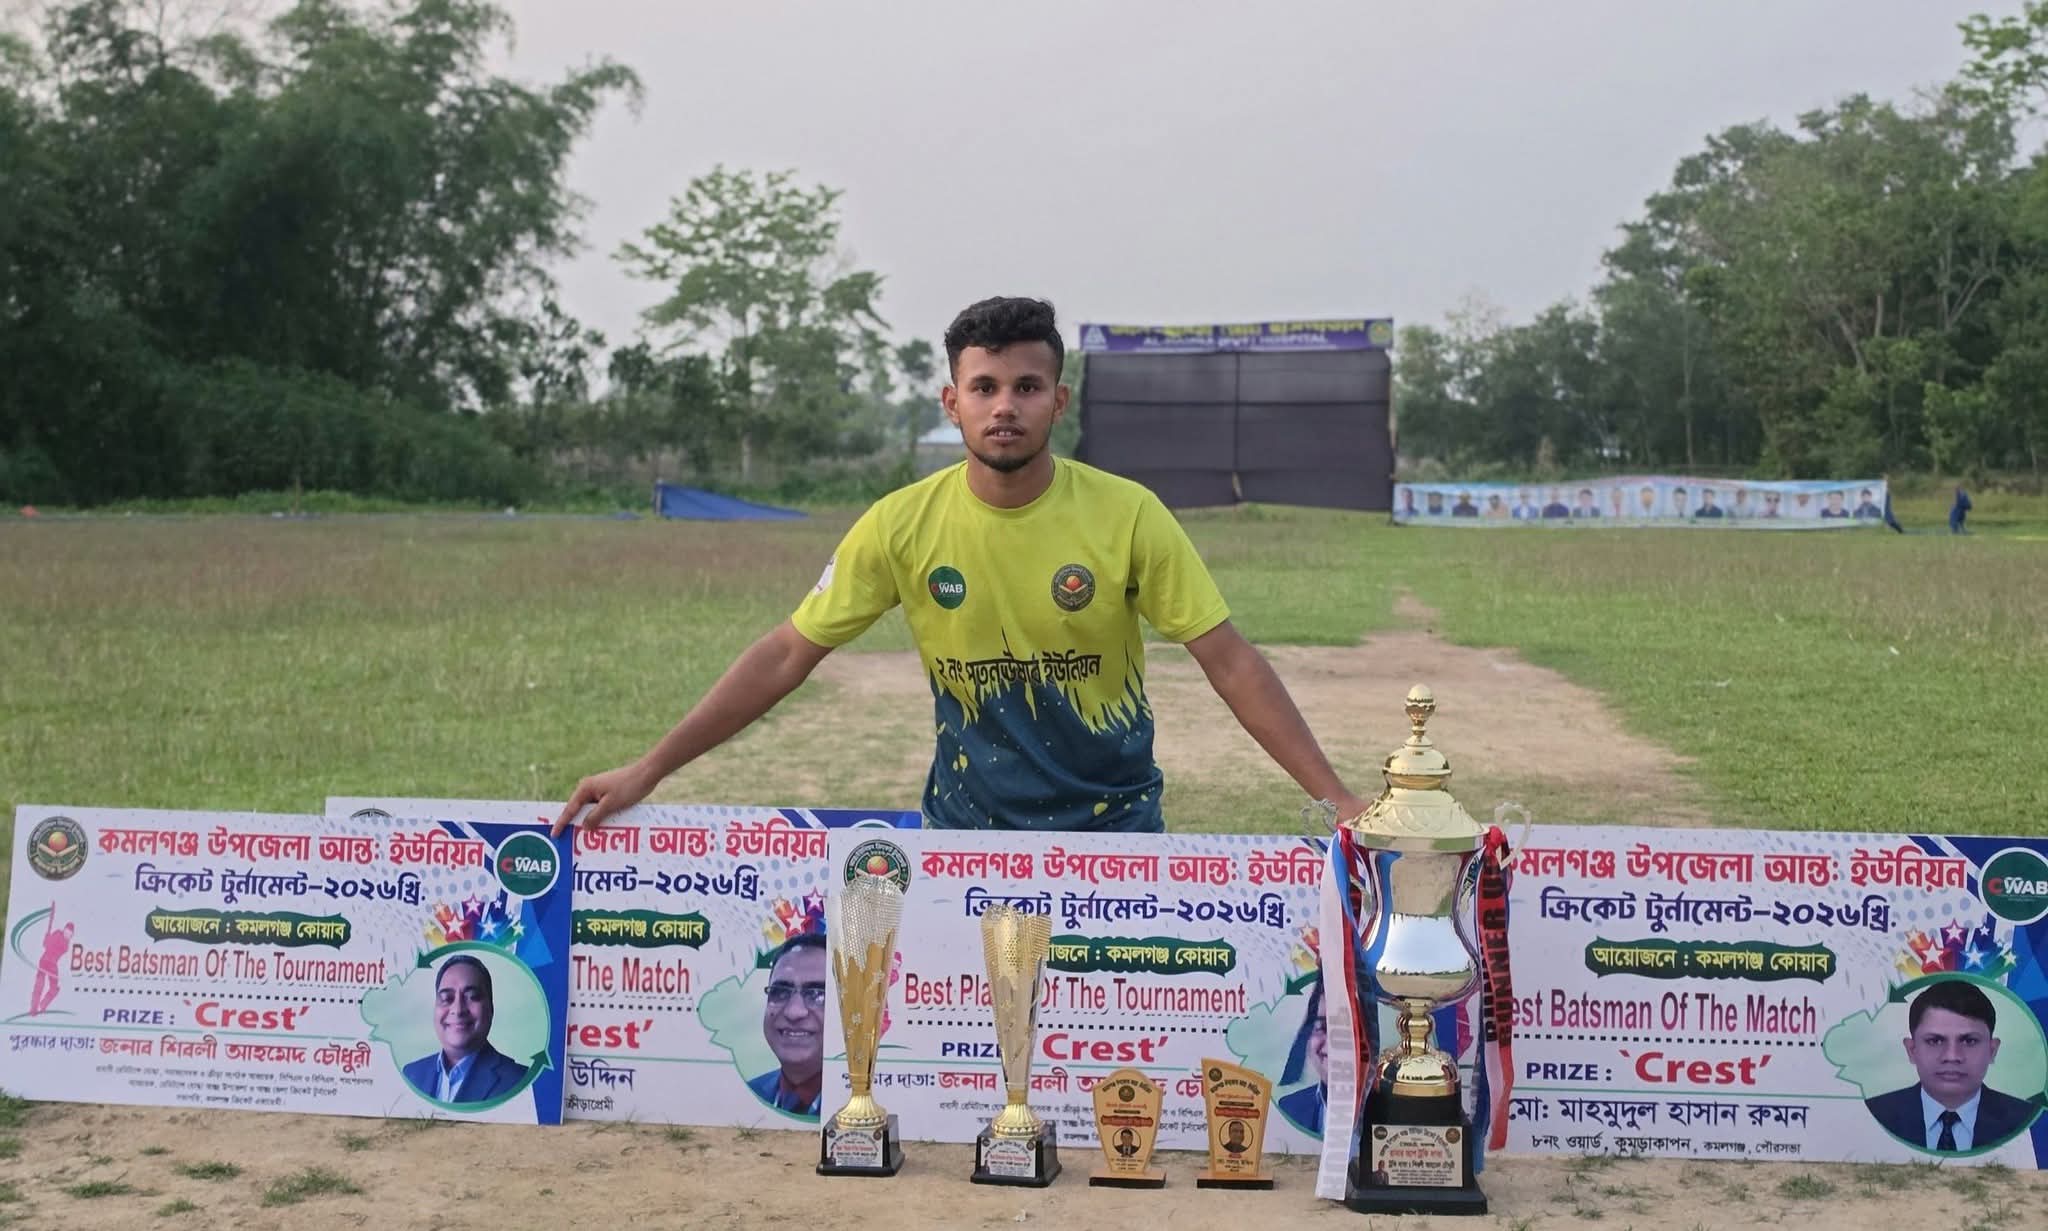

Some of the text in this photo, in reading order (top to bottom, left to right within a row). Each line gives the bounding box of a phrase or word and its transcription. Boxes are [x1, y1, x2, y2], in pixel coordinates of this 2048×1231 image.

[931, 582, 963, 594] CWAB
[1041, 648, 1102, 684] ইউনিয়ন
[98, 828, 199, 857] কমলগঞ্জ
[207, 825, 311, 862] উপজেলা
[389, 829, 485, 870] ইউনিয়ন
[725, 818, 828, 862] ইউনিয়ন
[135, 862, 214, 895] ক্রিকেট
[501, 856, 552, 873] CWAB
[921, 851, 1034, 879] কমলগঞ্জ
[1043, 846, 1160, 885] উপজেলা
[1627, 843, 1754, 885] উপজেলা
[1850, 845, 1967, 892] ইউনিয়ন
[1988, 877, 2048, 896] CWAB
[1540, 886, 1636, 922] ক্রিকেট
[235, 919, 292, 938] কমলগঞ্জ
[297, 922, 346, 940] কোয়াব
[587, 918, 646, 938] কমলগঞ্জ
[653, 921, 705, 940] কোয়াব
[70, 943, 386, 984] Best Batsman Of The Tournament
[1106, 945, 1169, 965] কমলগঞ্জ
[1175, 947, 1231, 967] কোয়াব
[1592, 947, 1678, 969] আয়োজনে
[1695, 950, 1763, 971] কমলগঞ্জ
[1770, 951, 1829, 973] কোয়াব
[573, 955, 690, 994] The Match
[905, 973, 951, 1005] Best
[960, 974, 992, 1006] Pla
[1066, 977, 1106, 1009] The
[1113, 978, 1246, 1013] Tournament
[103, 1008, 164, 1025] PRIZE
[1511, 989, 1816, 1034] est Batsman Of The Match
[99, 1037, 153, 1057] জনাব
[160, 1034, 217, 1059] শিবলী
[225, 1043, 308, 1064] আহমেদ
[314, 1041, 372, 1075] চৌধুরী
[570, 1058, 637, 1090] উদ্দিন
[938, 1071, 997, 1093] জনাব
[1526, 1062, 1599, 1081] PRIZE
[1558, 1097, 1660, 1130] মাহমুদুল
[1667, 1101, 1740, 1128] হাসান
[1747, 1104, 1811, 1129] রুমন
[1532, 1134, 1559, 1150] ৮নং
